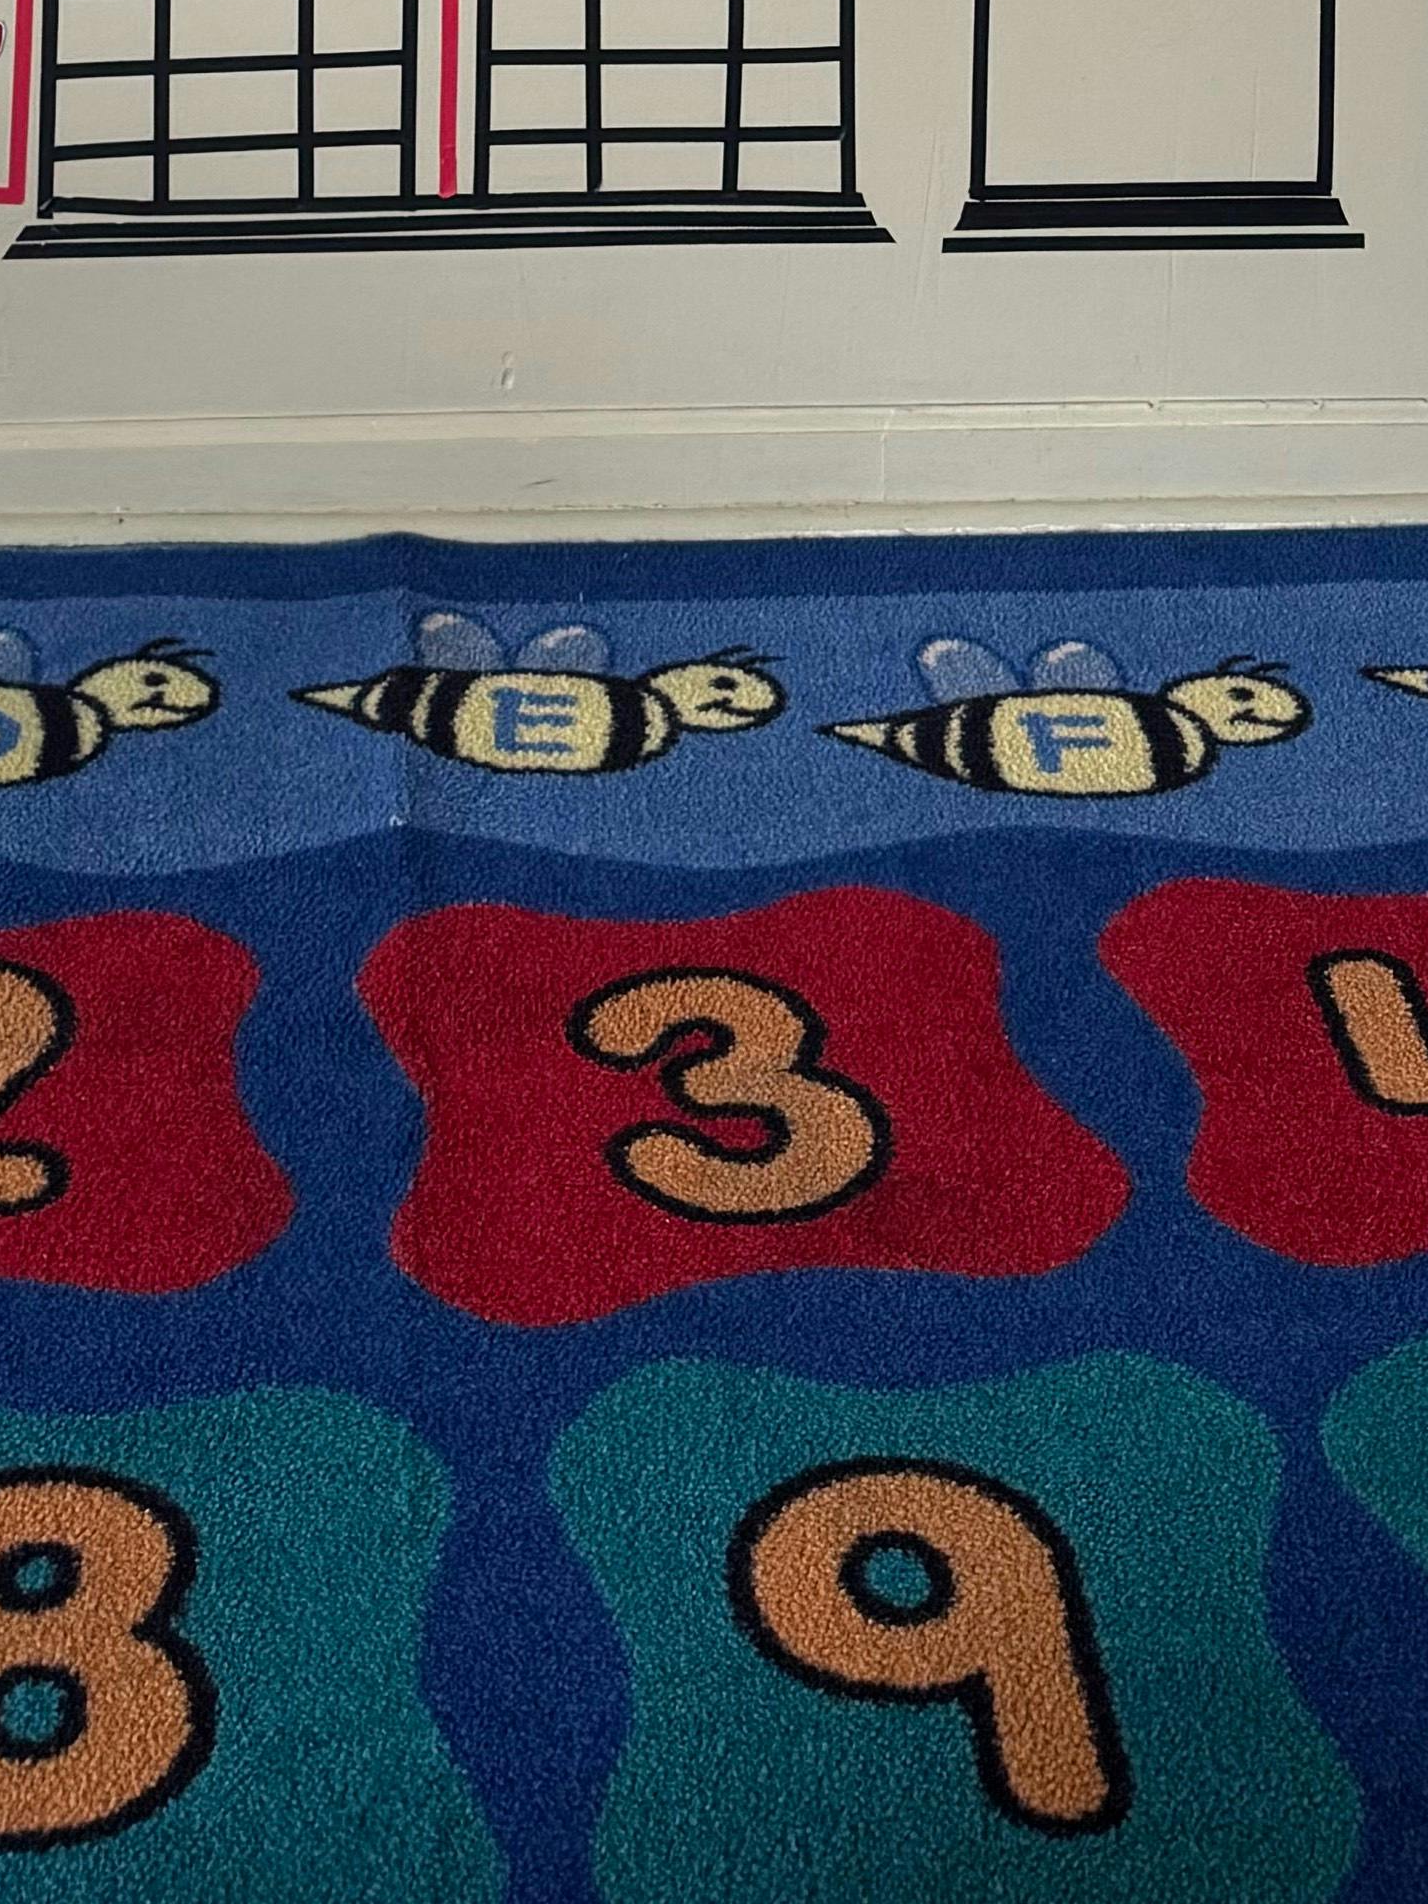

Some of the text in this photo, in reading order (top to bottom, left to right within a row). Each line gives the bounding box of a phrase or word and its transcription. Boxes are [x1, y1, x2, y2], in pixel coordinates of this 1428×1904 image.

[492, 686, 575, 752] E
[1017, 710, 1113, 774] F
[572, 966, 890, 1223] 3
[727, 1456, 1131, 1838] 9
